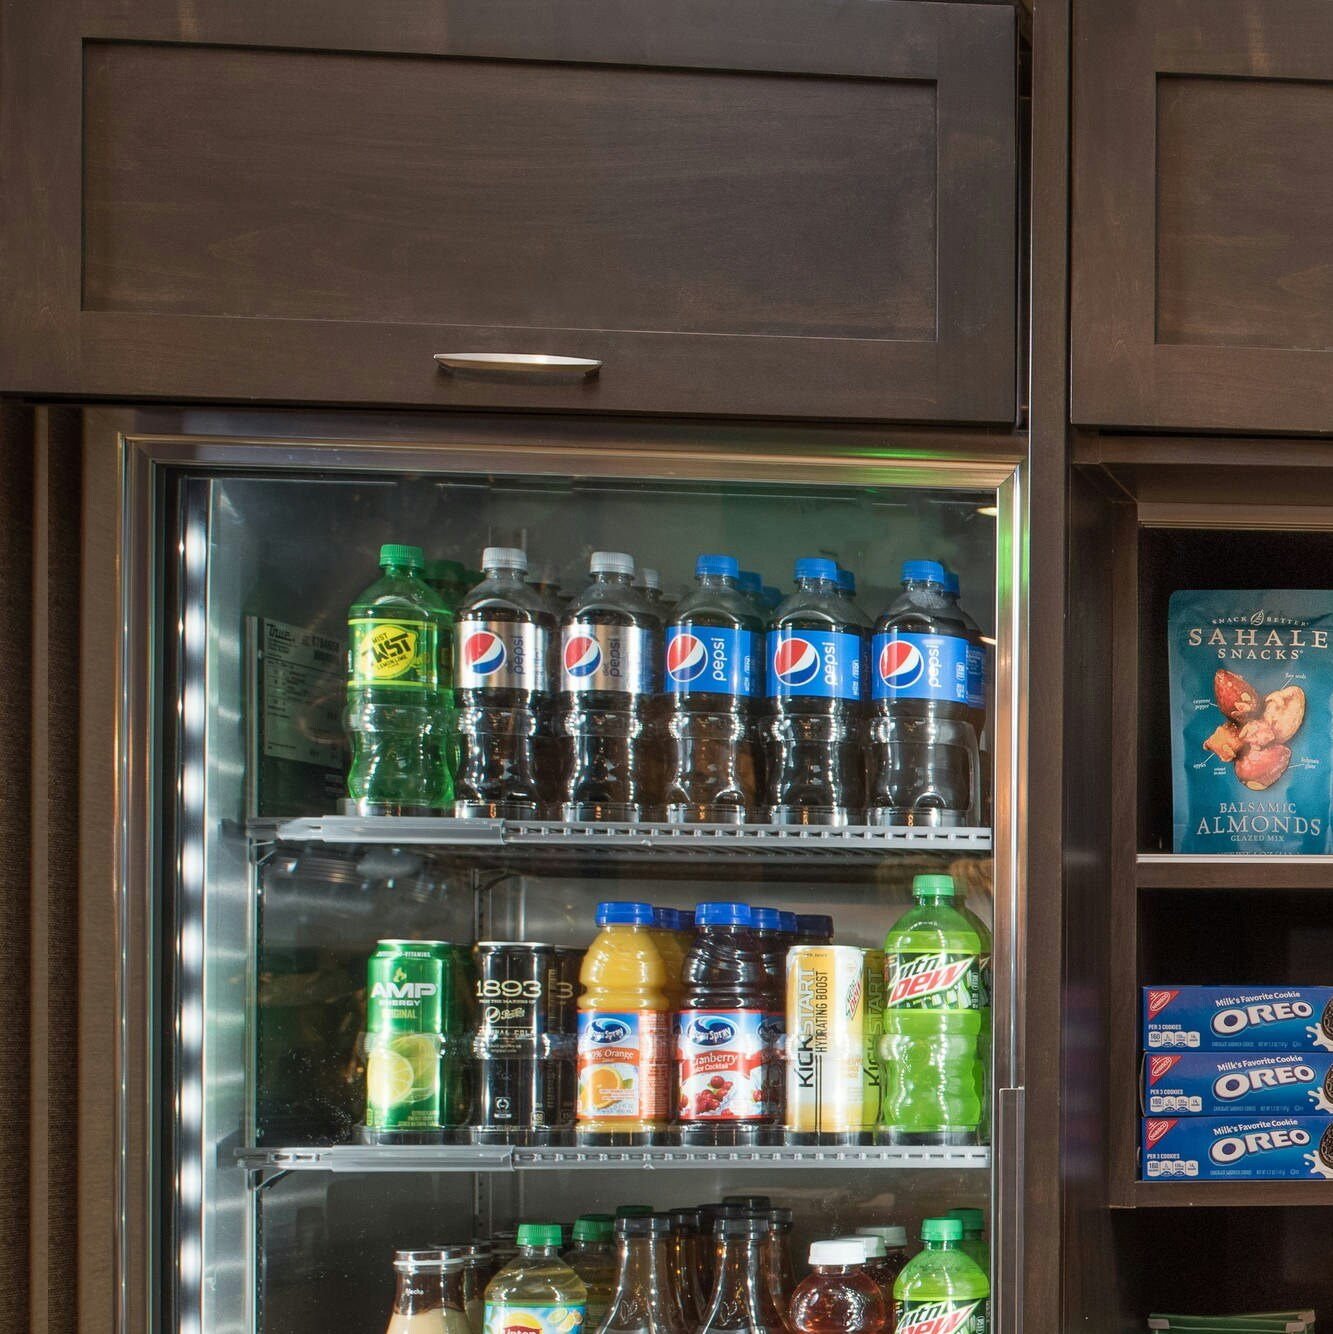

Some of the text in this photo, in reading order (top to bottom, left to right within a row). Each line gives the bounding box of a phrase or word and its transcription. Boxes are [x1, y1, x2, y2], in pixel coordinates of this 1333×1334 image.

[1212, 616, 1309, 627] SNACK BETTER
[1188, 627, 1328, 649] SAHALE
[711, 637, 728, 682] pepsi
[822, 641, 838, 686] pepsi
[1217, 649, 1303, 660] SNACKS
[926, 644, 942, 688] pepsi
[1220, 802, 1297, 814] BALSAMIC
[1196, 815, 1321, 837] ALMONDS
[370, 982, 437, 999] AMP
[476, 979, 542, 997] 1893
[1212, 1001, 1314, 1036] OREO
[605, 1049, 635, 1060] Orange
[1217, 1055, 1303, 1072] Milk's Favorite Cookie
[1214, 1065, 1315, 1100] OREO
[1213, 1118, 1298, 1136] Milk's Favorite Cookie
[1209, 1128, 1311, 1164] OREO
